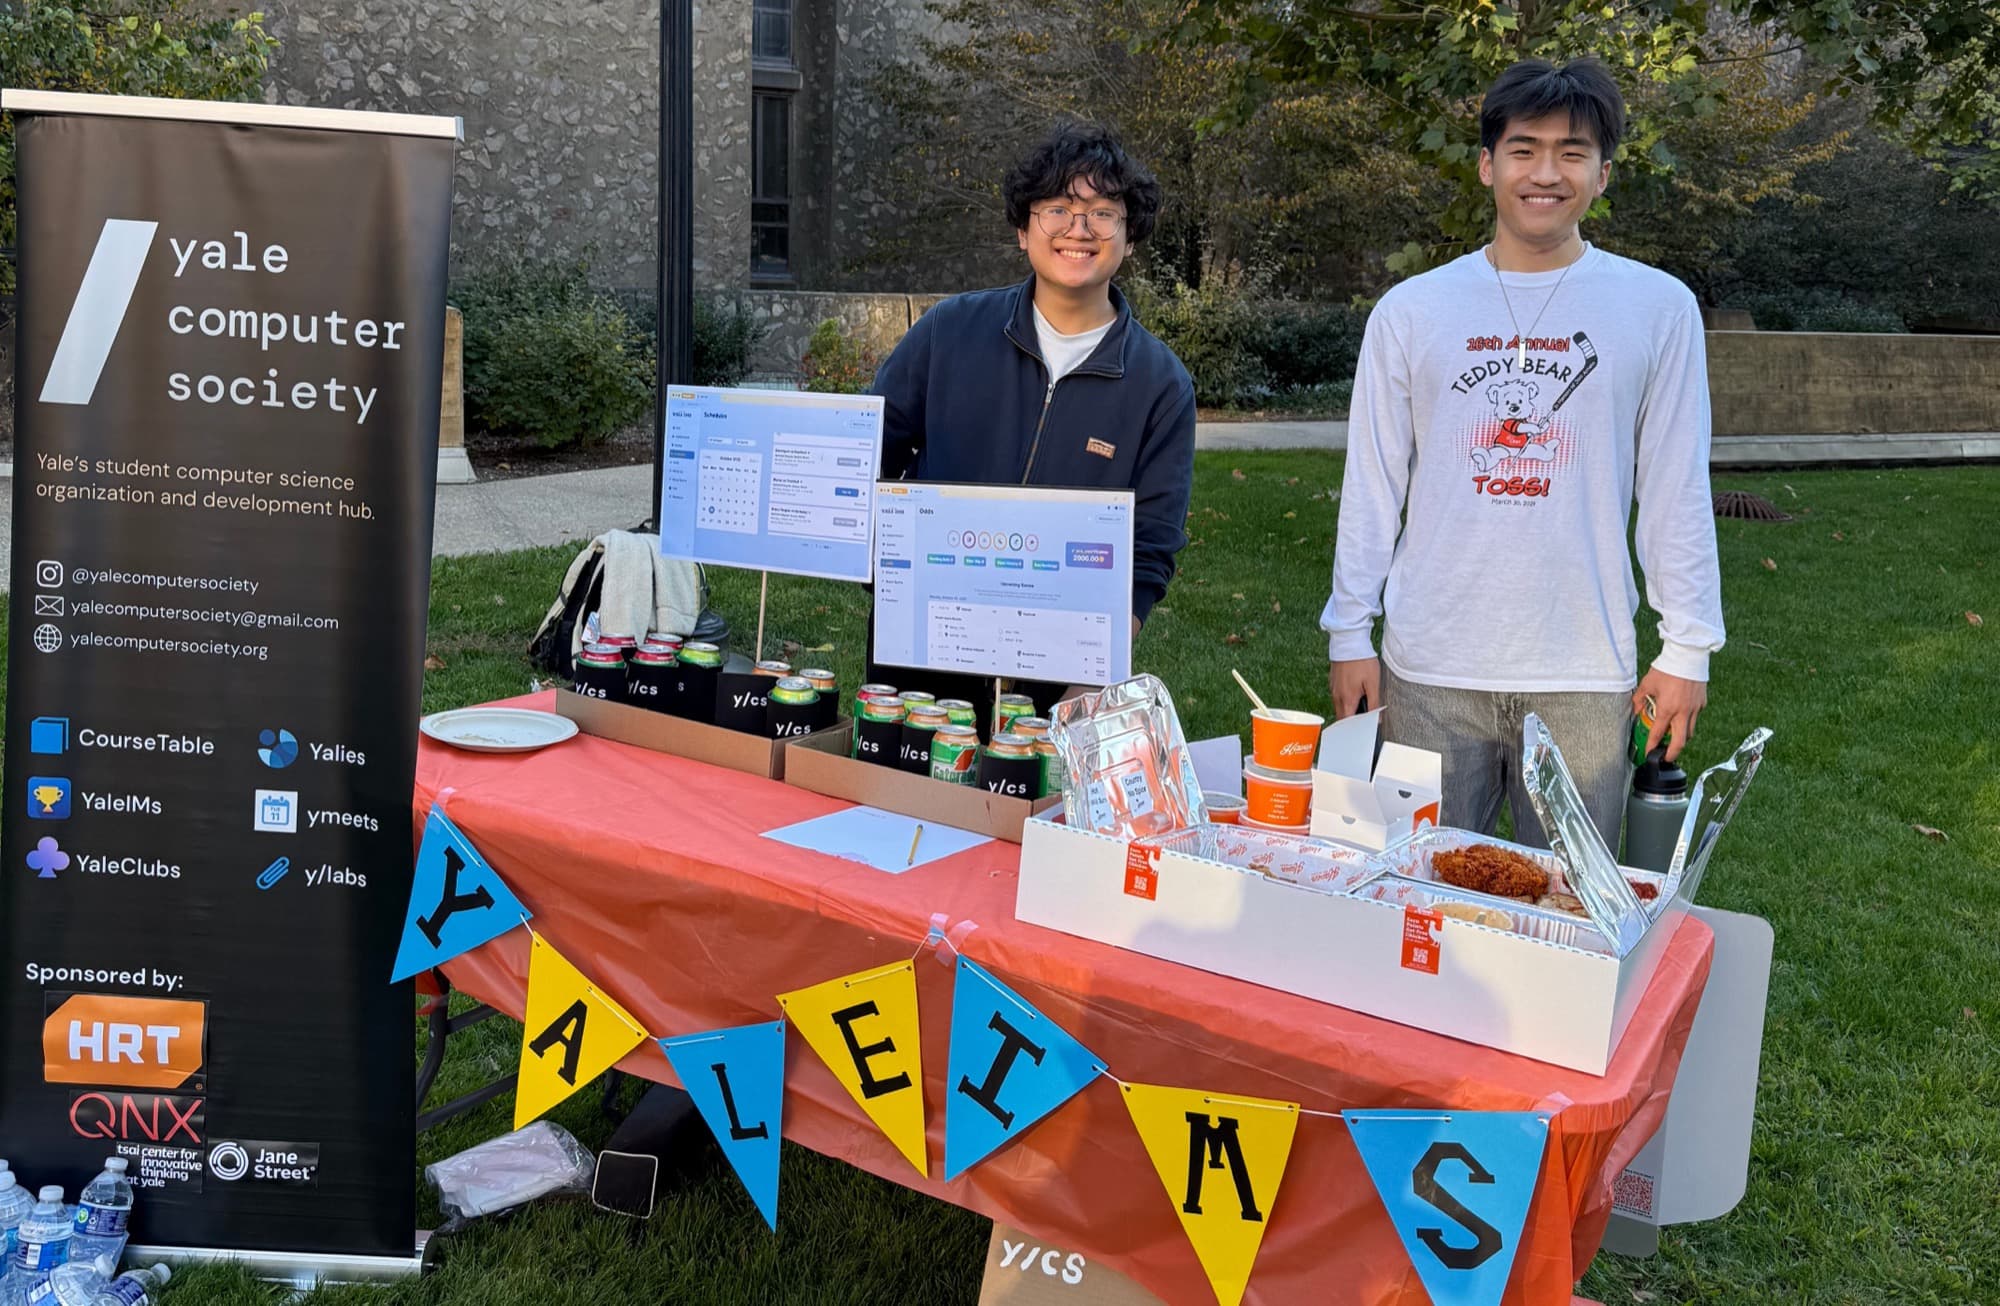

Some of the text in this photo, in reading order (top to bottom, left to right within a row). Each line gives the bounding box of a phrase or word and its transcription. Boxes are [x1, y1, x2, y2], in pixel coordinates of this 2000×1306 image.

[169, 231, 289, 277] yale
[168, 305, 405, 350] computer
[1505, 334, 1570, 352] Annual
[1451, 358, 1572, 395] TEDDY BEAR
[168, 369, 377, 424] society
[95, 457, 171, 478] student
[176, 465, 273, 496] computer
[279, 470, 355, 492] science
[1472, 475, 1550, 497] TOSS!
[36, 482, 375, 520] organization and development hub.
[1491, 498, 1512, 506] March
[72, 567, 259, 596] @yalecomputersociety
[71, 600, 339, 630] yalecomputersociety@gmail.com
[70, 633, 268, 660] yalecomputersociety.org
[733, 691, 768, 708] y/cs
[776, 721, 811, 736] y/cs
[79, 729, 215, 756] CourseTable
[310, 742, 366, 766] Yalies
[857, 735, 879, 753] /cs
[82, 792, 162, 815] YaleIMs
[307, 809, 379, 832] ymeets
[76, 853, 181, 879] YaleClubs
[305, 864, 367, 888] y/labs
[26, 963, 184, 992] Sponsored by:
[68, 1020, 180, 1064] HRT
[70, 1092, 203, 1143] QNX
[117, 1144, 197, 1160] tsai center for
[141, 1157, 202, 1170] innovative
[255, 1149, 298, 1164] Jane
[127, 1175, 165, 1188] at yale
[141, 1167, 188, 1181] thinking
